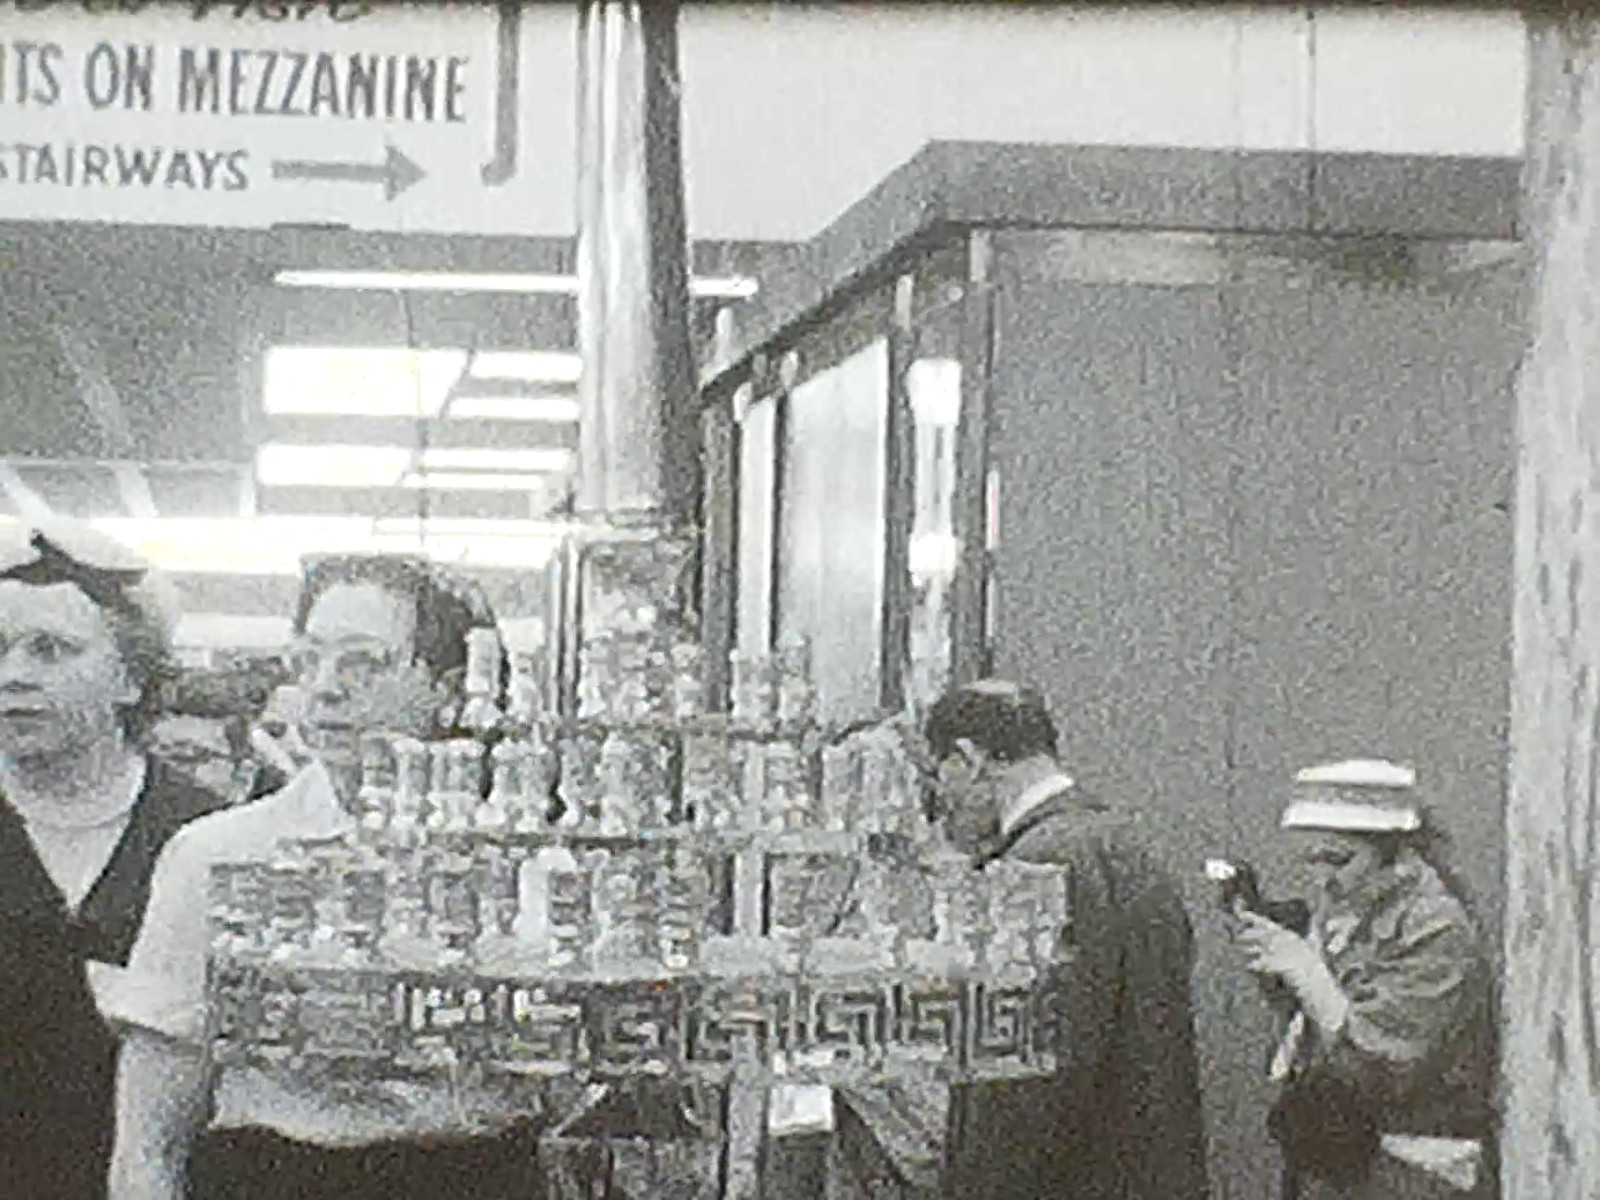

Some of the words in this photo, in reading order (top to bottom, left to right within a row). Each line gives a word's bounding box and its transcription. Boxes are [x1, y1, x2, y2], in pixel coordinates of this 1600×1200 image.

[0, 42, 62, 104] TS
[84, 42, 154, 110] ON
[178, 48, 469, 122] MEZZANINE
